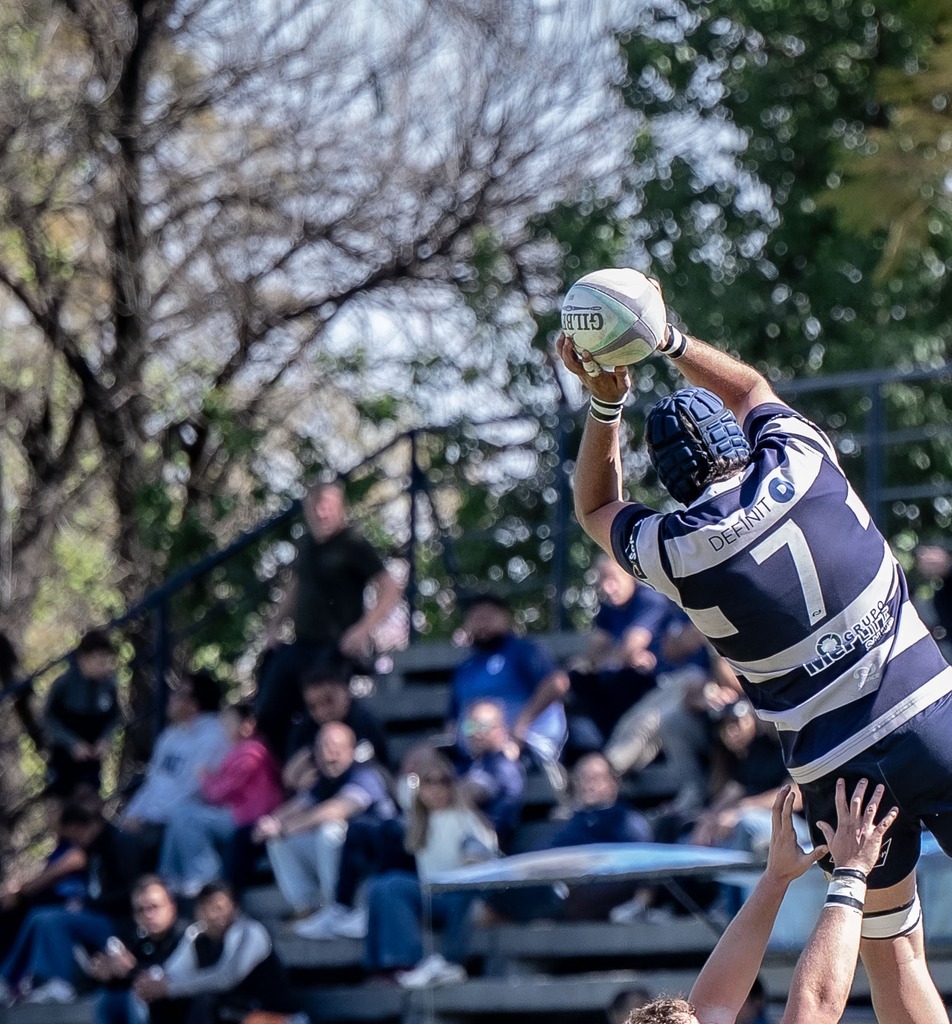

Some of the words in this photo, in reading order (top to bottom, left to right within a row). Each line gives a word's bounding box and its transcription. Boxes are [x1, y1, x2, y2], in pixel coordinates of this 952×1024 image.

[708, 496, 771, 552] DEFINIT
[749, 518, 827, 626] 7
[844, 600, 885, 642] GRUPO
